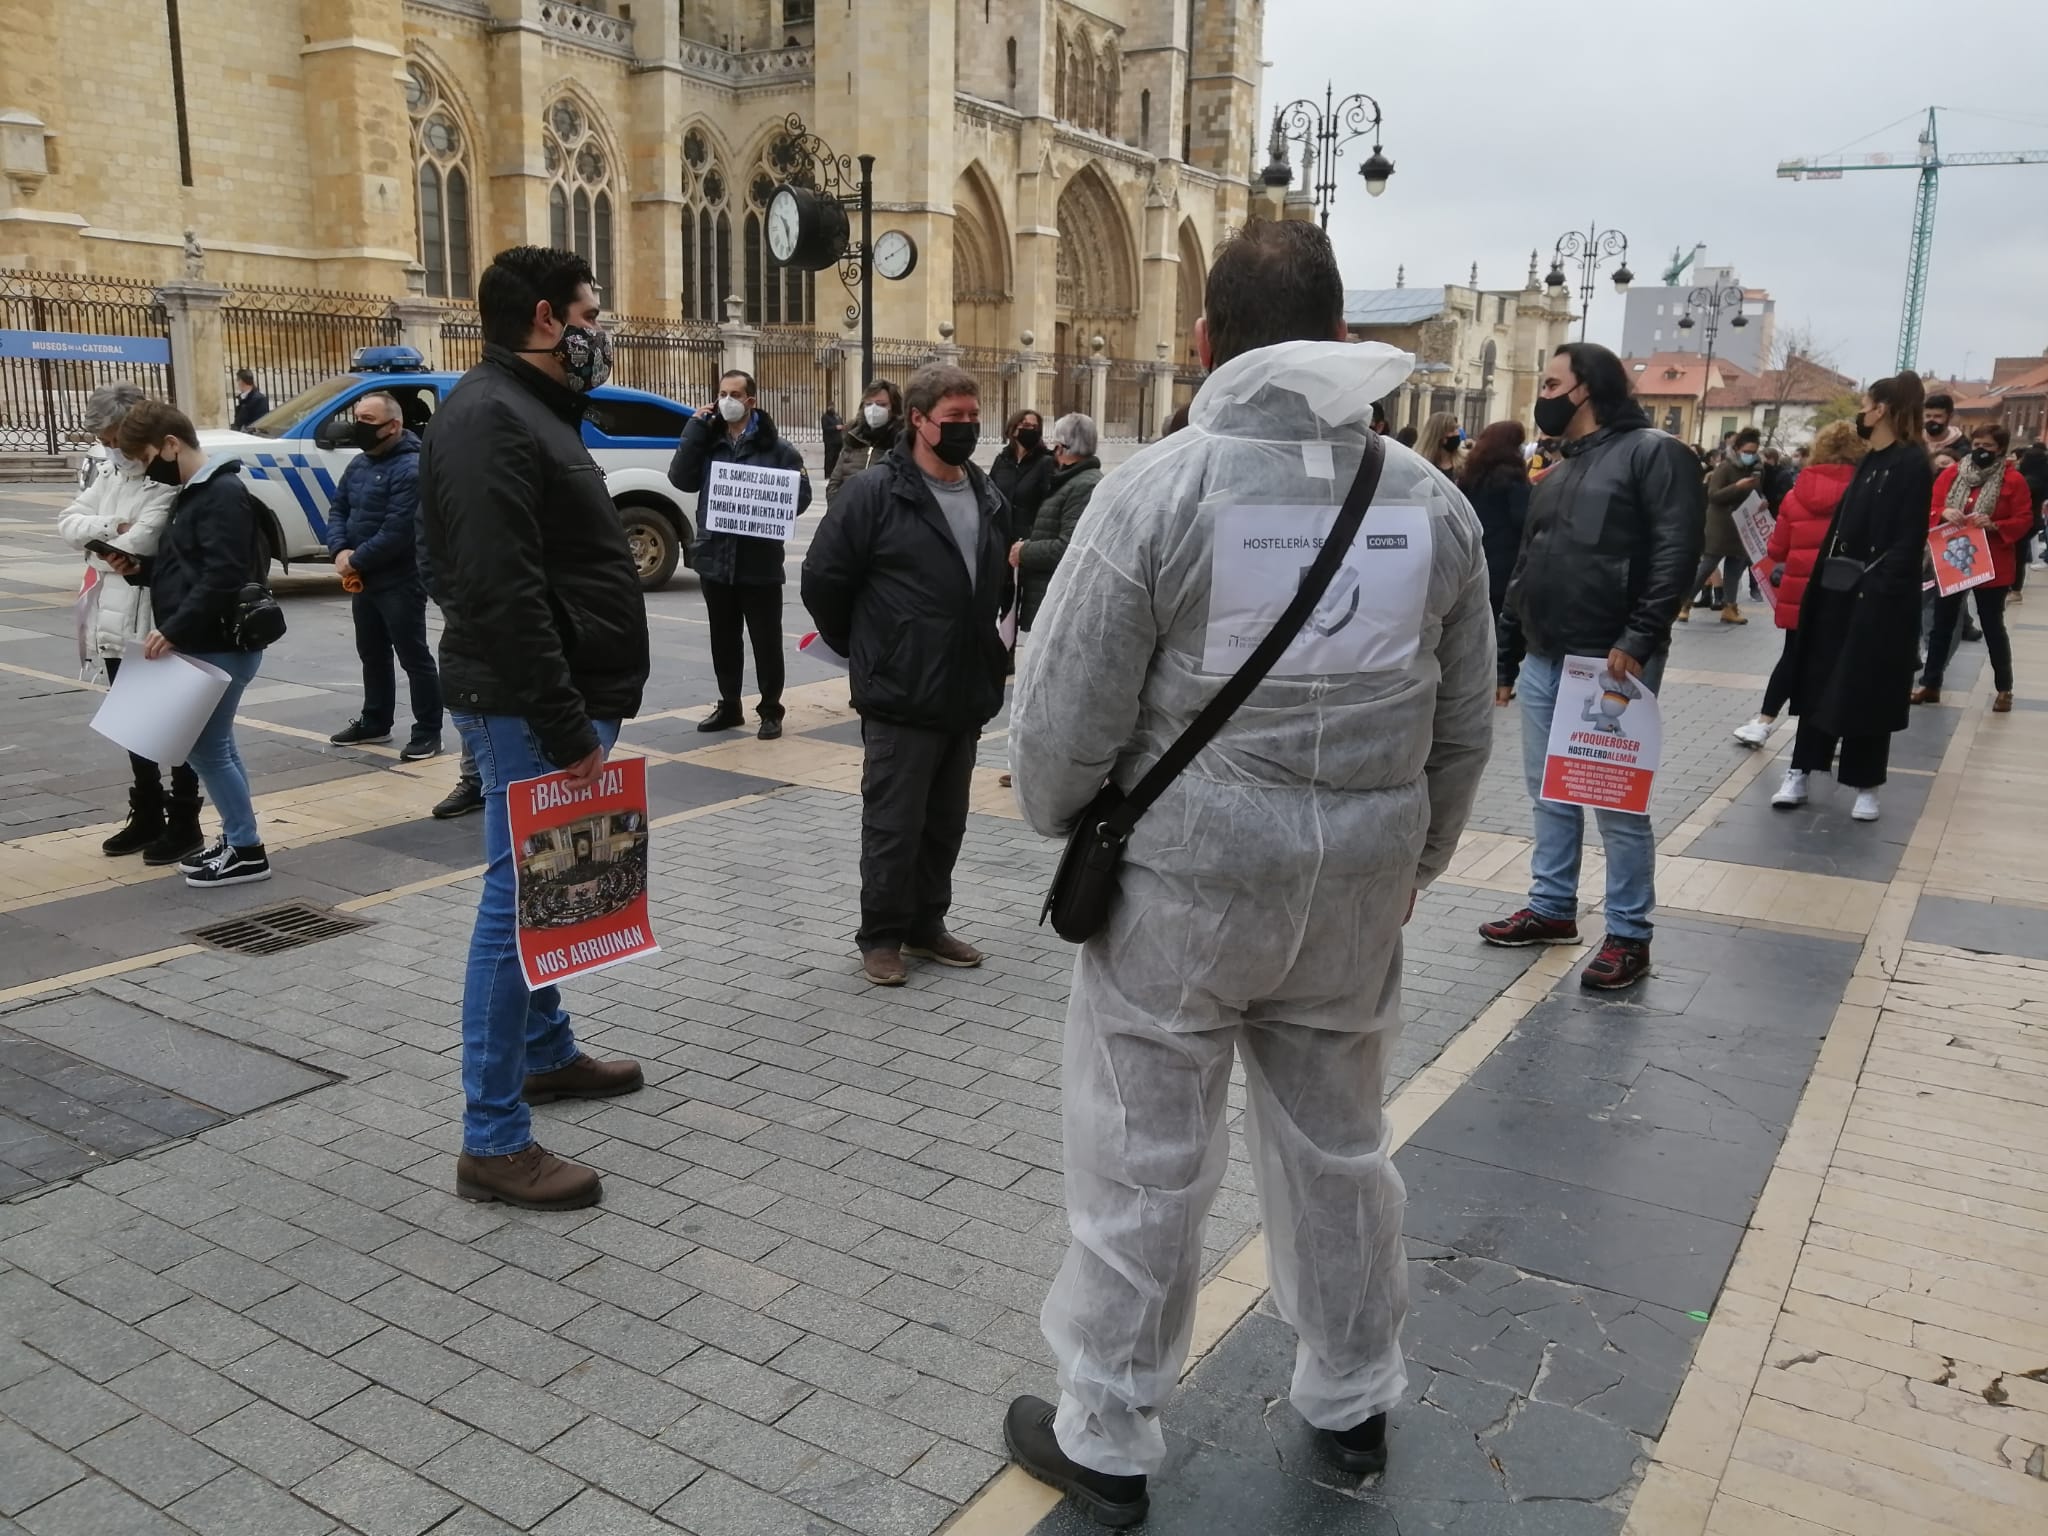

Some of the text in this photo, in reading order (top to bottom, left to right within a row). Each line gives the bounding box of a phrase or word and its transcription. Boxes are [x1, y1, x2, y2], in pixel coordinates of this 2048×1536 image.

[32, 341, 68, 351] MUSEOS
[82, 344, 124, 354] CATEDRAL
[730, 470, 758, 484] SANCHEZ
[760, 472, 775, 486] SÓLO
[776, 476, 790, 488] NOS
[713, 484, 792, 504] QUEDA LA ESPERANZA QUE
[710, 499, 794, 521] TAMBIÉN NOS MIENTA EN LA
[715, 516, 785, 536] SUBIDA DE IMPUESTOS
[1753, 511, 1774, 541] LEÓ
[1244, 536, 1310, 550] HOSTELERÍA
[1370, 537, 1406, 546] COVID-19
[1570, 732, 1640, 752] #YOQUIEROSER
[598, 768, 623, 797] YA!
[536, 925, 645, 976] NOS ARRUINAN
